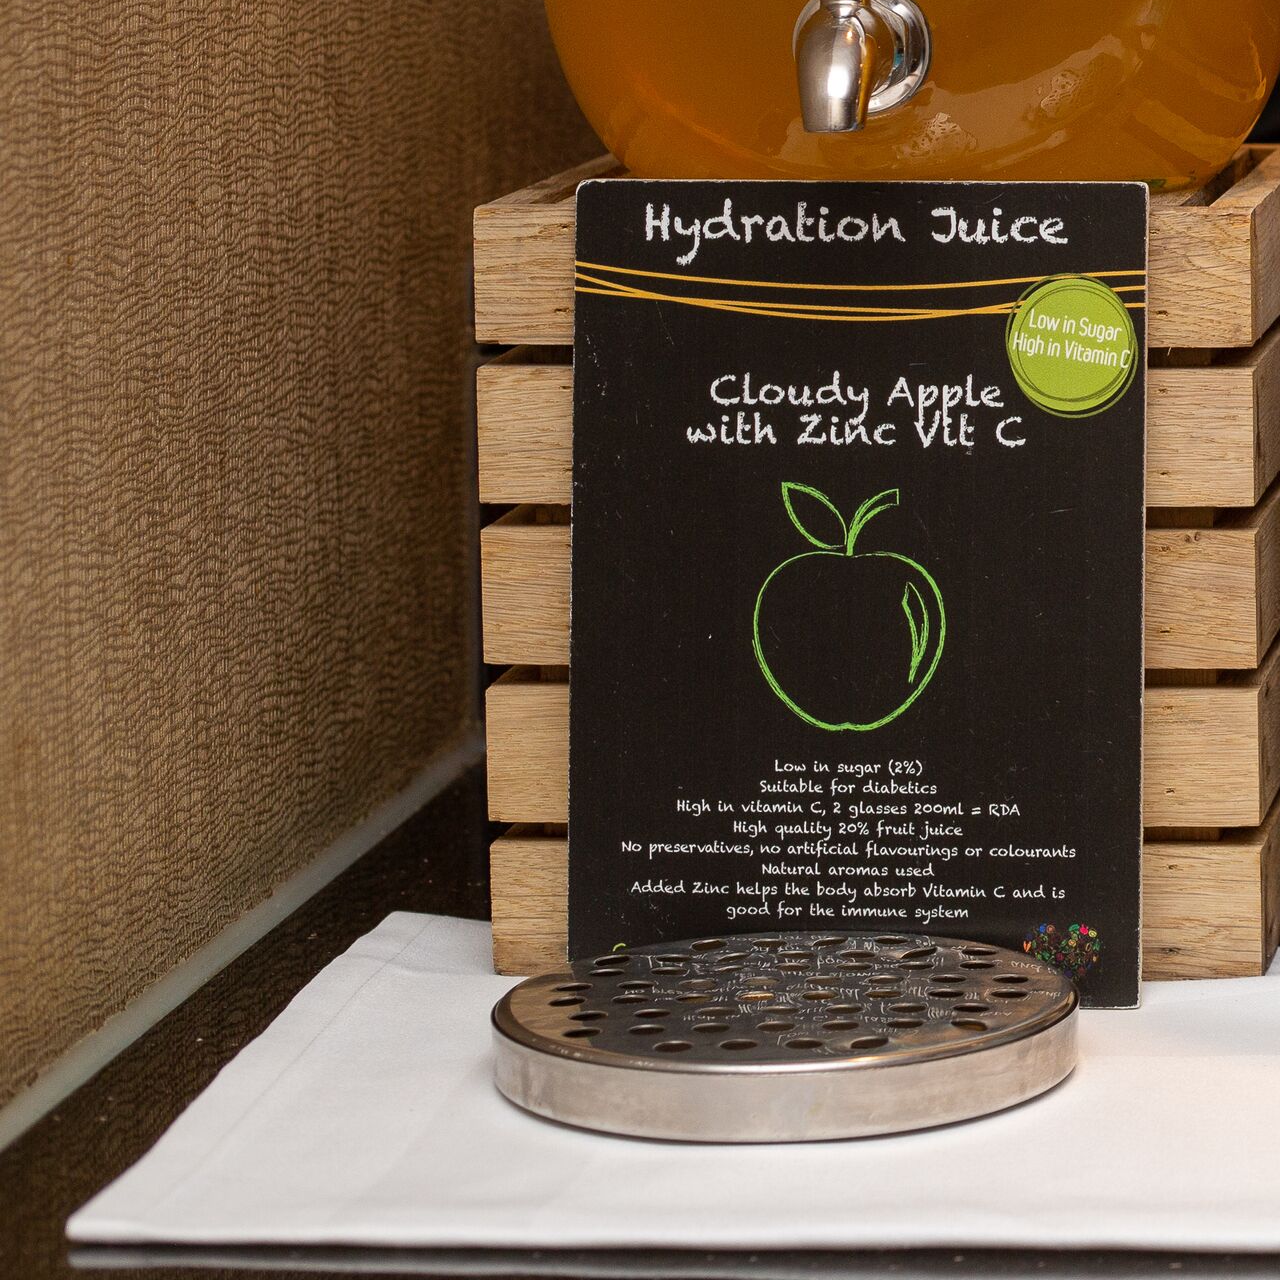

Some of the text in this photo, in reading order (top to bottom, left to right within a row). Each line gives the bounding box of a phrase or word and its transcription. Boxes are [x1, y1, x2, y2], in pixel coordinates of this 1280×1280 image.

[645, 197, 1069, 267] Hydration Juice
[1029, 309, 1122, 342] Low in Sugar
[1013, 331, 1130, 368] High in Vitamin C
[710, 371, 1004, 426] Cloudy Apple
[687, 410, 777, 445] with
[797, 414, 896, 445] Zinc
[996, 416, 1026, 447] C
[774, 758, 923, 779] Low in sugar (2%)
[759, 777, 937, 797] Suitable for diabetics
[676, 798, 711, 817] High
[717, 801, 735, 813] in
[741, 799, 804, 814] vitamin
[810, 801, 826, 817] C,
[833, 801, 841, 814] 2
[848, 800, 908, 819] glasses
[914, 802, 964, 816] 200ml
[988, 803, 1021, 817] RDA
[733, 819, 964, 843] High quality 20% fruit juice
[621, 838, 1076, 862] No preservatives, no artificial flavourings or colourants
[761, 861, 935, 877] Natural aromas used
[630, 879, 1066, 905] Added Zinc helps the body absorb Vitamin C and is
[726, 899, 969, 925] good for the immune system
